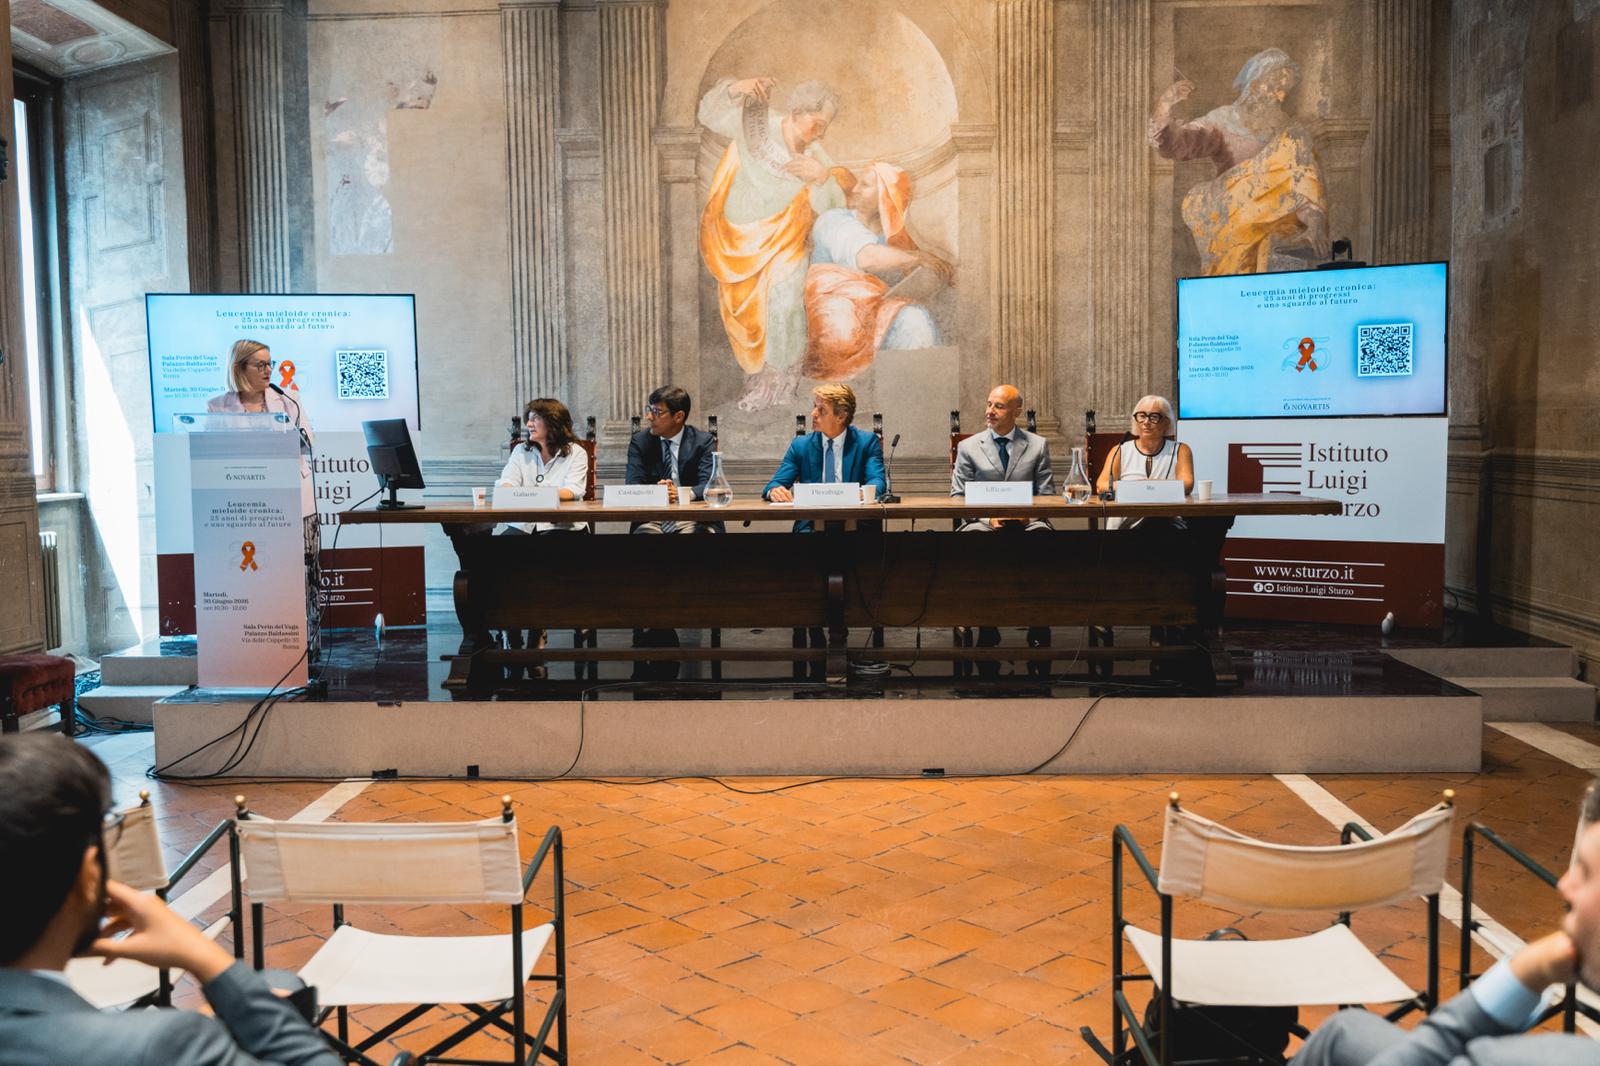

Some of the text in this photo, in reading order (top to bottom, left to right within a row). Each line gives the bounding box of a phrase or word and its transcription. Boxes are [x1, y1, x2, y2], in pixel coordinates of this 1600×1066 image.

[1240, 284, 1376, 298] Leucemia mieloide cronica:
[1310, 292, 1350, 300] progressi
[1282, 300, 1316, 308] sguardo
[1308, 442, 1389, 463] Istituto
[313, 454, 370, 473] tituto
[1307, 470, 1368, 495] Luigi
[316, 480, 352, 505] uigi
[1254, 566, 1354, 580] www.sturzo.it
[1276, 583, 1354, 596] Istituto Luigi Sturzo
